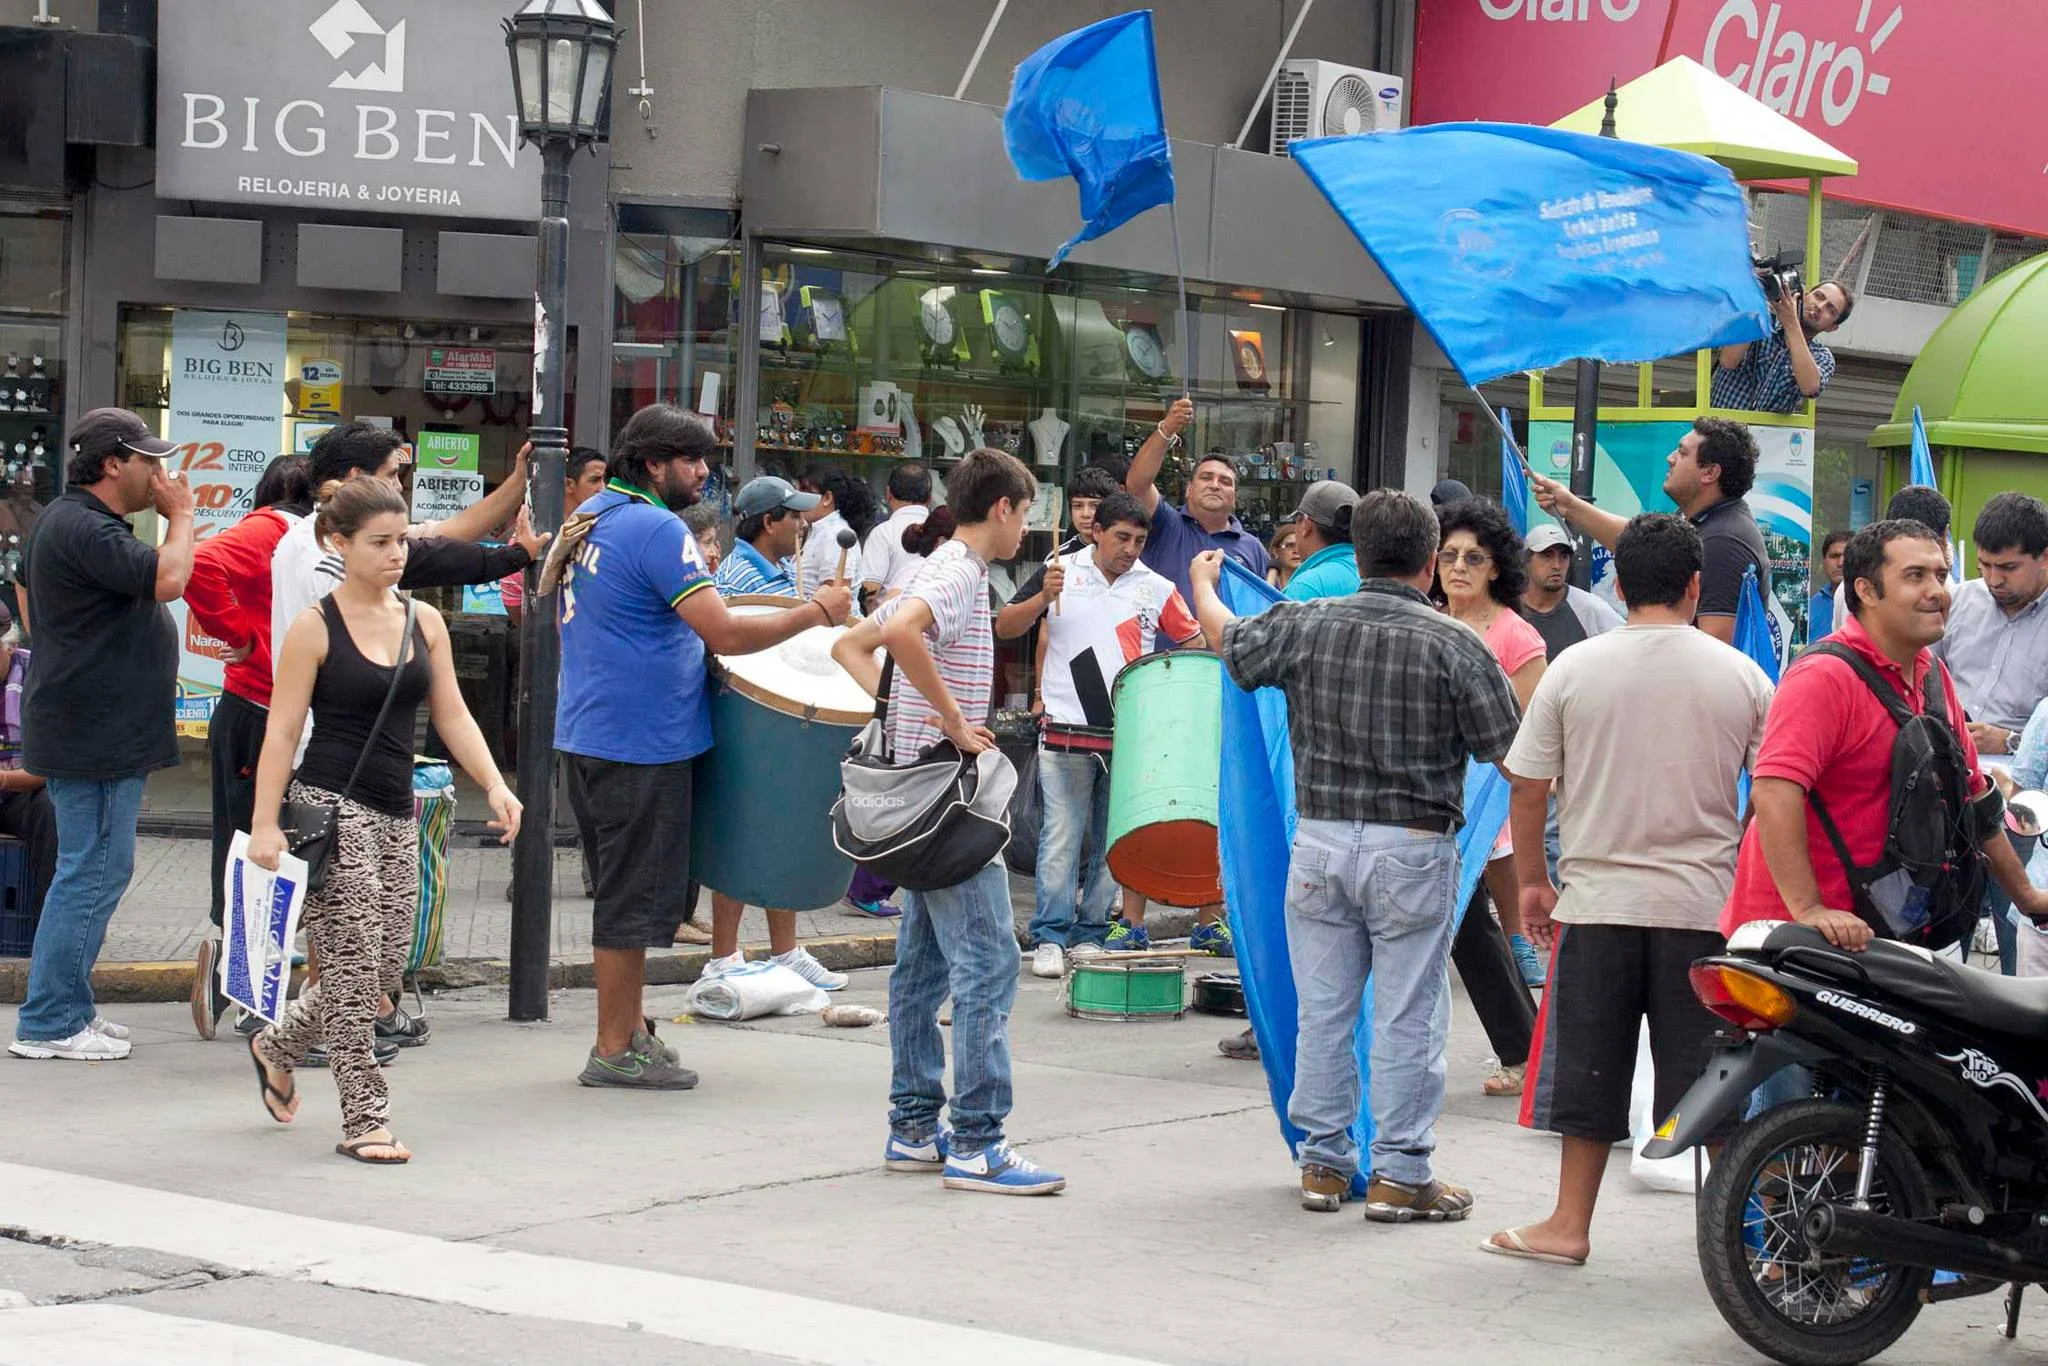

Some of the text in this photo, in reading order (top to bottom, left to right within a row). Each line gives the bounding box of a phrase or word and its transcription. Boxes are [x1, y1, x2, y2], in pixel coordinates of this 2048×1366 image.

[182, 93, 519, 169] BIG BEN
[237, 176, 462, 206] RELOJERIA & JOYERIA
[184, 357, 275, 378] BIG BEN
[302, 366, 320, 380] 12
[184, 373, 229, 382] RELOJES
[241, 377, 273, 385] JOYAS
[431, 381, 447, 391] Tel:
[192, 411, 222, 419] GRANDES
[223, 413, 276, 422] OPORTUNIDADES
[428, 436, 469, 451] ABIERTO
[180, 442, 266, 472] 12 CERO
[229, 463, 265, 473] INTERES
[416, 478, 481, 491] ABIERTO
[193, 483, 254, 510] 10%
[416, 502, 472, 512] ACONDICIONA
[681, 534, 703, 571] 4
[851, 794, 906, 808] adidas
[1815, 990, 1916, 1035] GUERRERO
[1962, 1047, 2000, 1076] Trip
